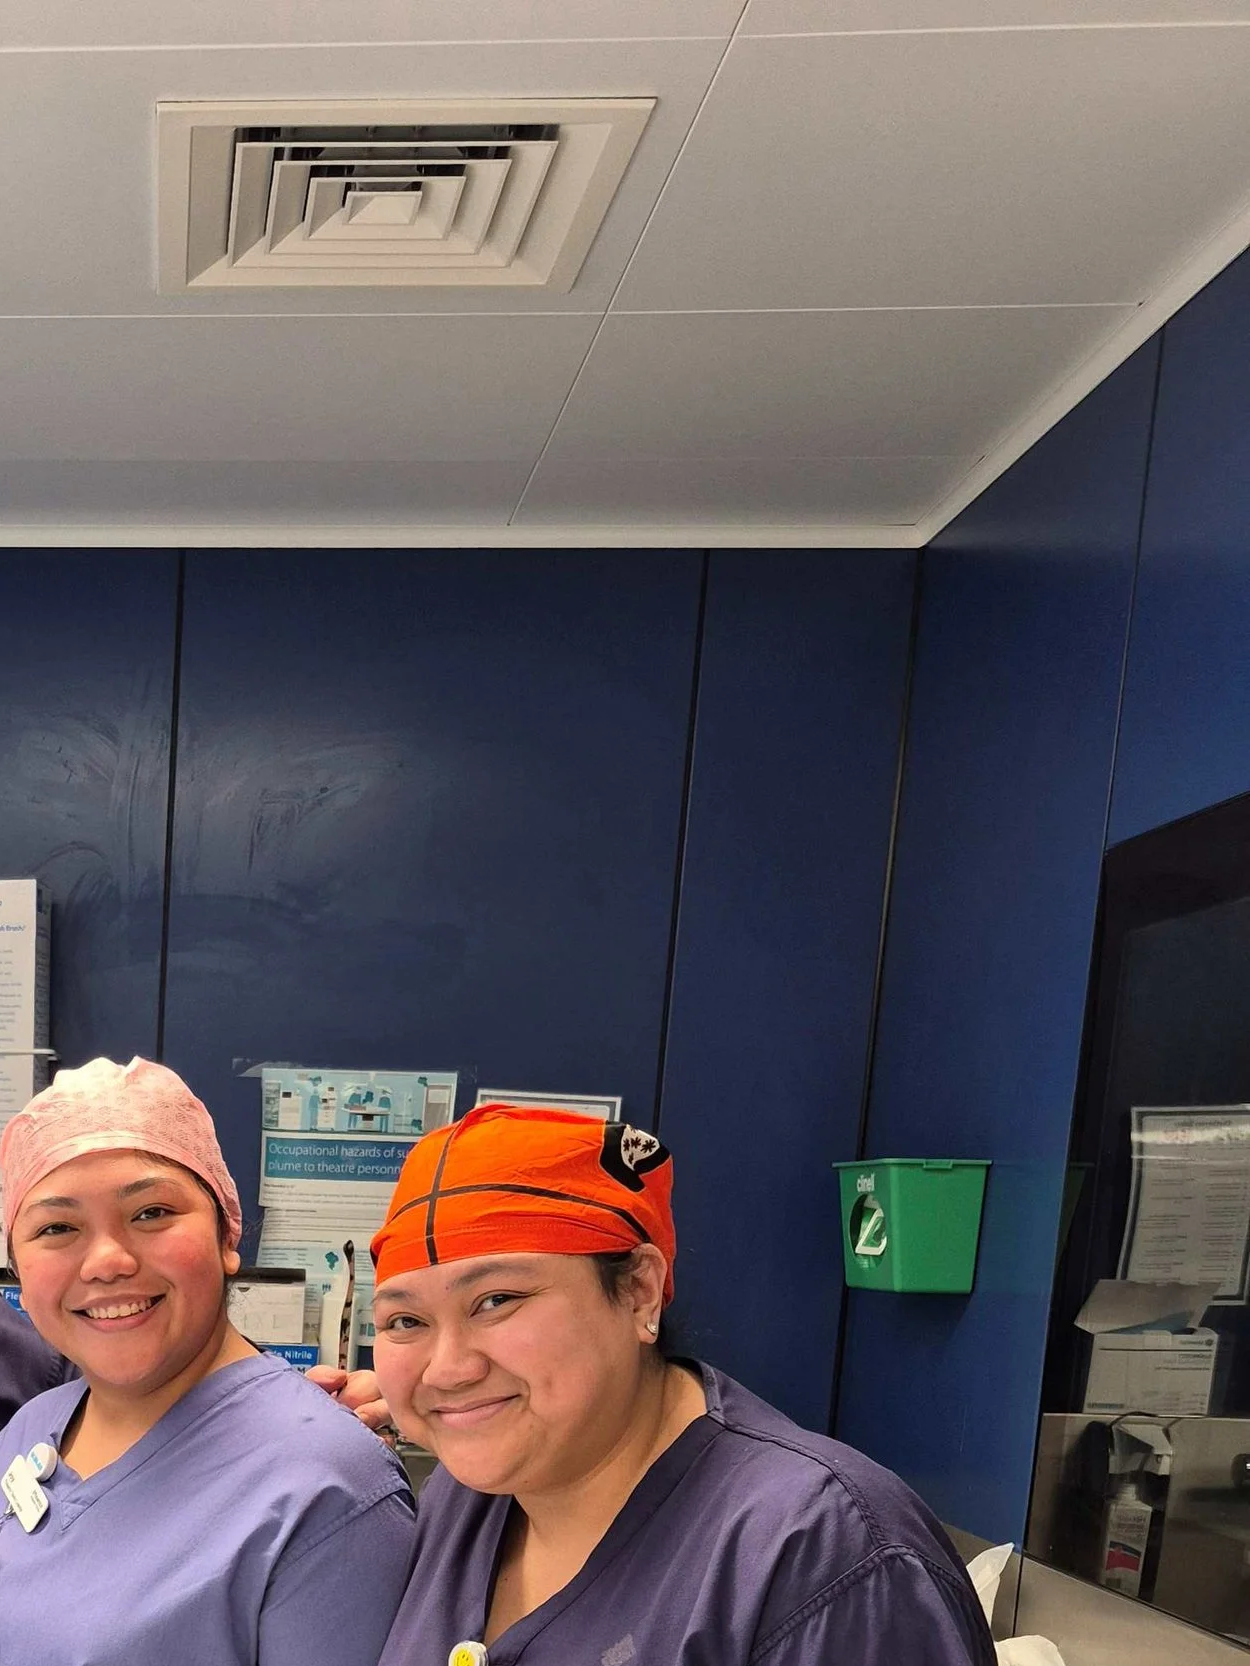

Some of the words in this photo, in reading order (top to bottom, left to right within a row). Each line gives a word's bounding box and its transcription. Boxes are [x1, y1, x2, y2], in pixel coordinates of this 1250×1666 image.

[268, 1143, 339, 1157] Occupational
[341, 1145, 381, 1158] hazards
[383, 1146, 395, 1158] of
[268, 1160, 301, 1174] plume
[304, 1162, 316, 1172] to
[317, 1162, 355, 1173] theatre
[357, 1165, 401, 1176] personn
[284, 1350, 312, 1360] Nitrile
